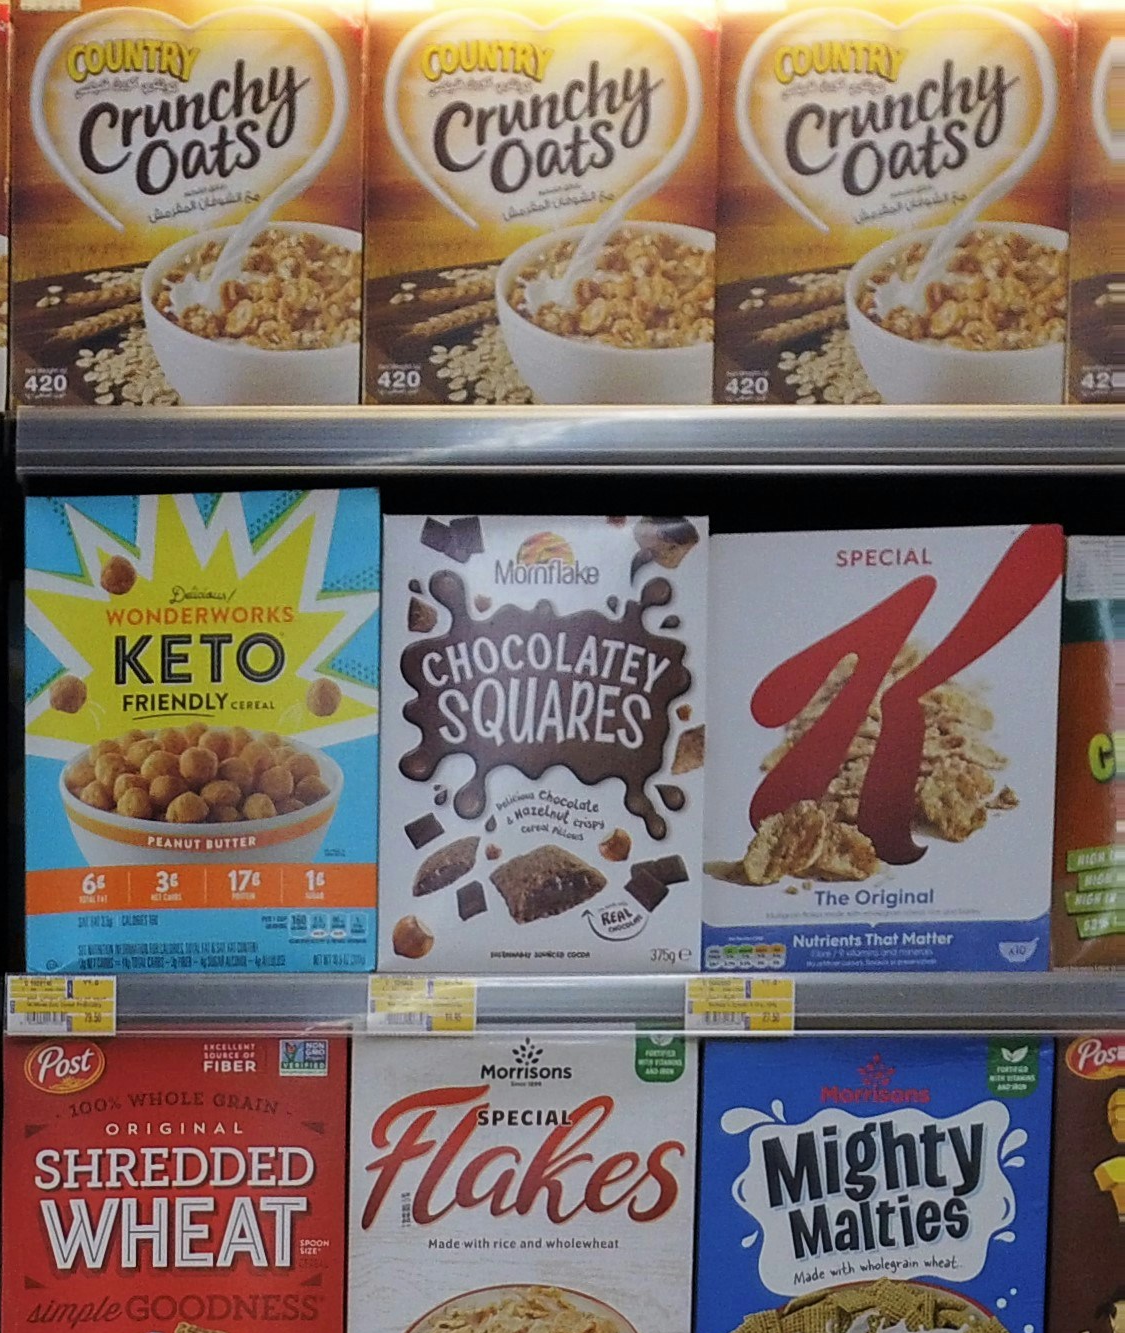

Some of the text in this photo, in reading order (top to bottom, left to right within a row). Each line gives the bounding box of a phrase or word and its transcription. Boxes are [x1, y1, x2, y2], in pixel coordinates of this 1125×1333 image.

[836, 548, 932, 568] SPECIAL
[495, 559, 599, 585] Mornflake
[105, 607, 294, 626] WONDERWORKS
[114, 633, 285, 685] KETO
[421, 633, 671, 693] CHOCOLATEY
[123, 693, 228, 711] FRIENDLY
[438, 676, 652, 749] SQUARES
[148, 836, 257, 848] PEANUT BUTTER
[814, 888, 934, 908] The Original
[793, 932, 954, 947] Nutrients That Matter
[37, 1050, 93, 1082] Post
[203, 1060, 257, 1073] FIBER
[480, 1065, 572, 1080] Morrisons
[477, 1109, 573, 1126] SPECIAL
[34, 1146, 315, 1190] SHREDDED
[361, 1085, 685, 1231] Flakes
[762, 1120, 985, 1208] Mighty
[40, 1197, 308, 1270] WHEAT
[789, 1197, 970, 1260] Malties
[428, 1237, 619, 1249] Made with rice and wholewheat
